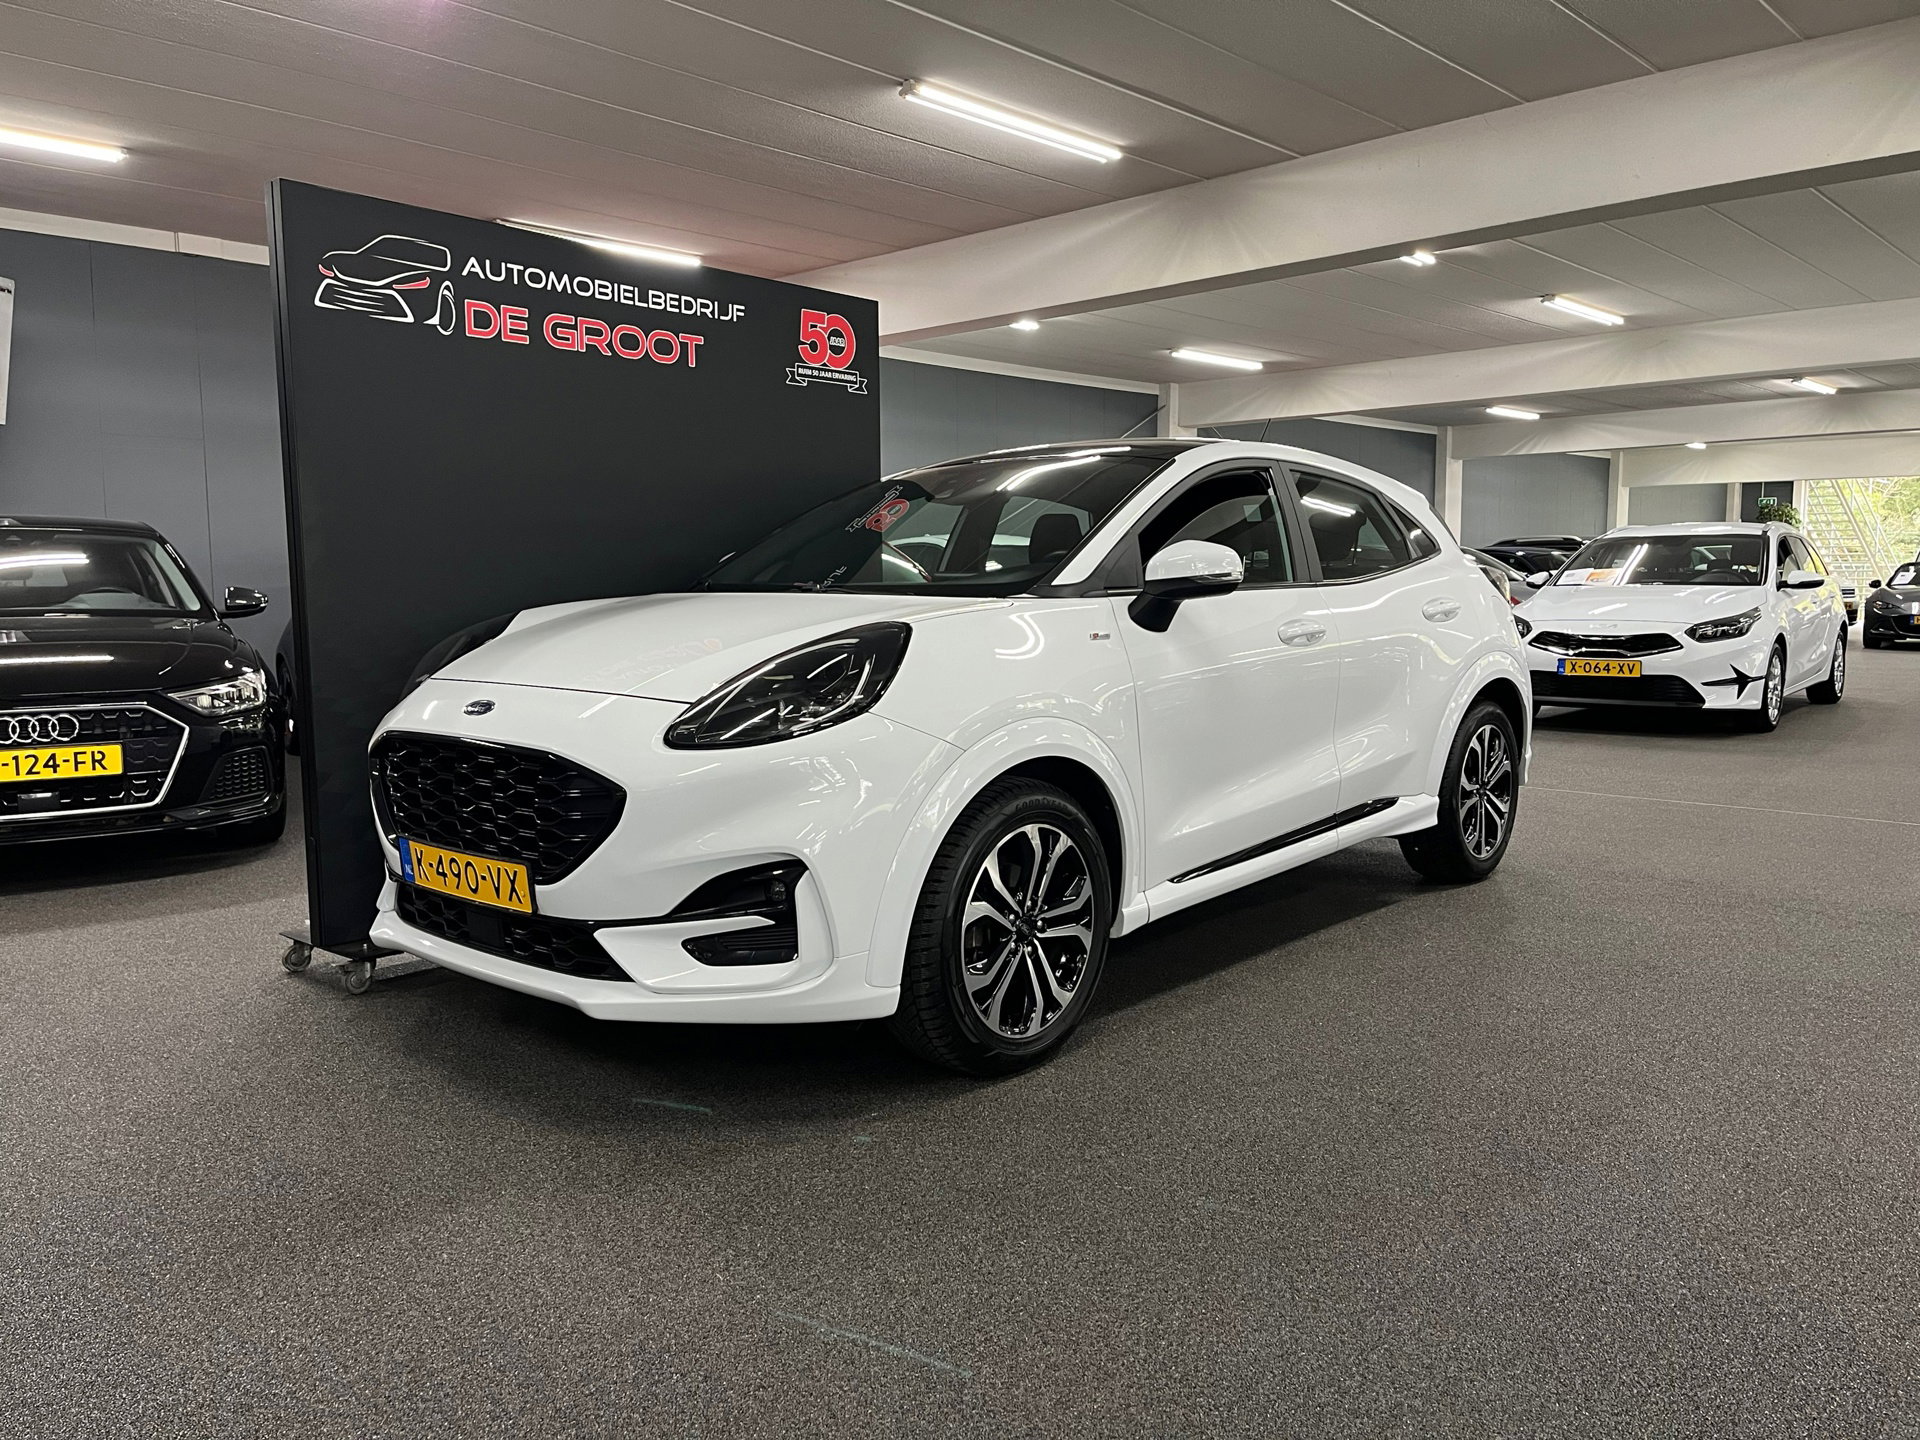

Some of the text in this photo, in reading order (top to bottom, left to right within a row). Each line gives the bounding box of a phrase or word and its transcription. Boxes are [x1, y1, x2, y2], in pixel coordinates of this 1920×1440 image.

[461, 256, 745, 322] AUTOMOBIELBEDRIJF
[464, 299, 704, 367] DE GROOT
[798, 308, 856, 369] 50
[832, 372, 857, 382] ERVARING
[1569, 661, 1636, 675] X-064-XV
[414, 847, 524, 904] K-490-VX
